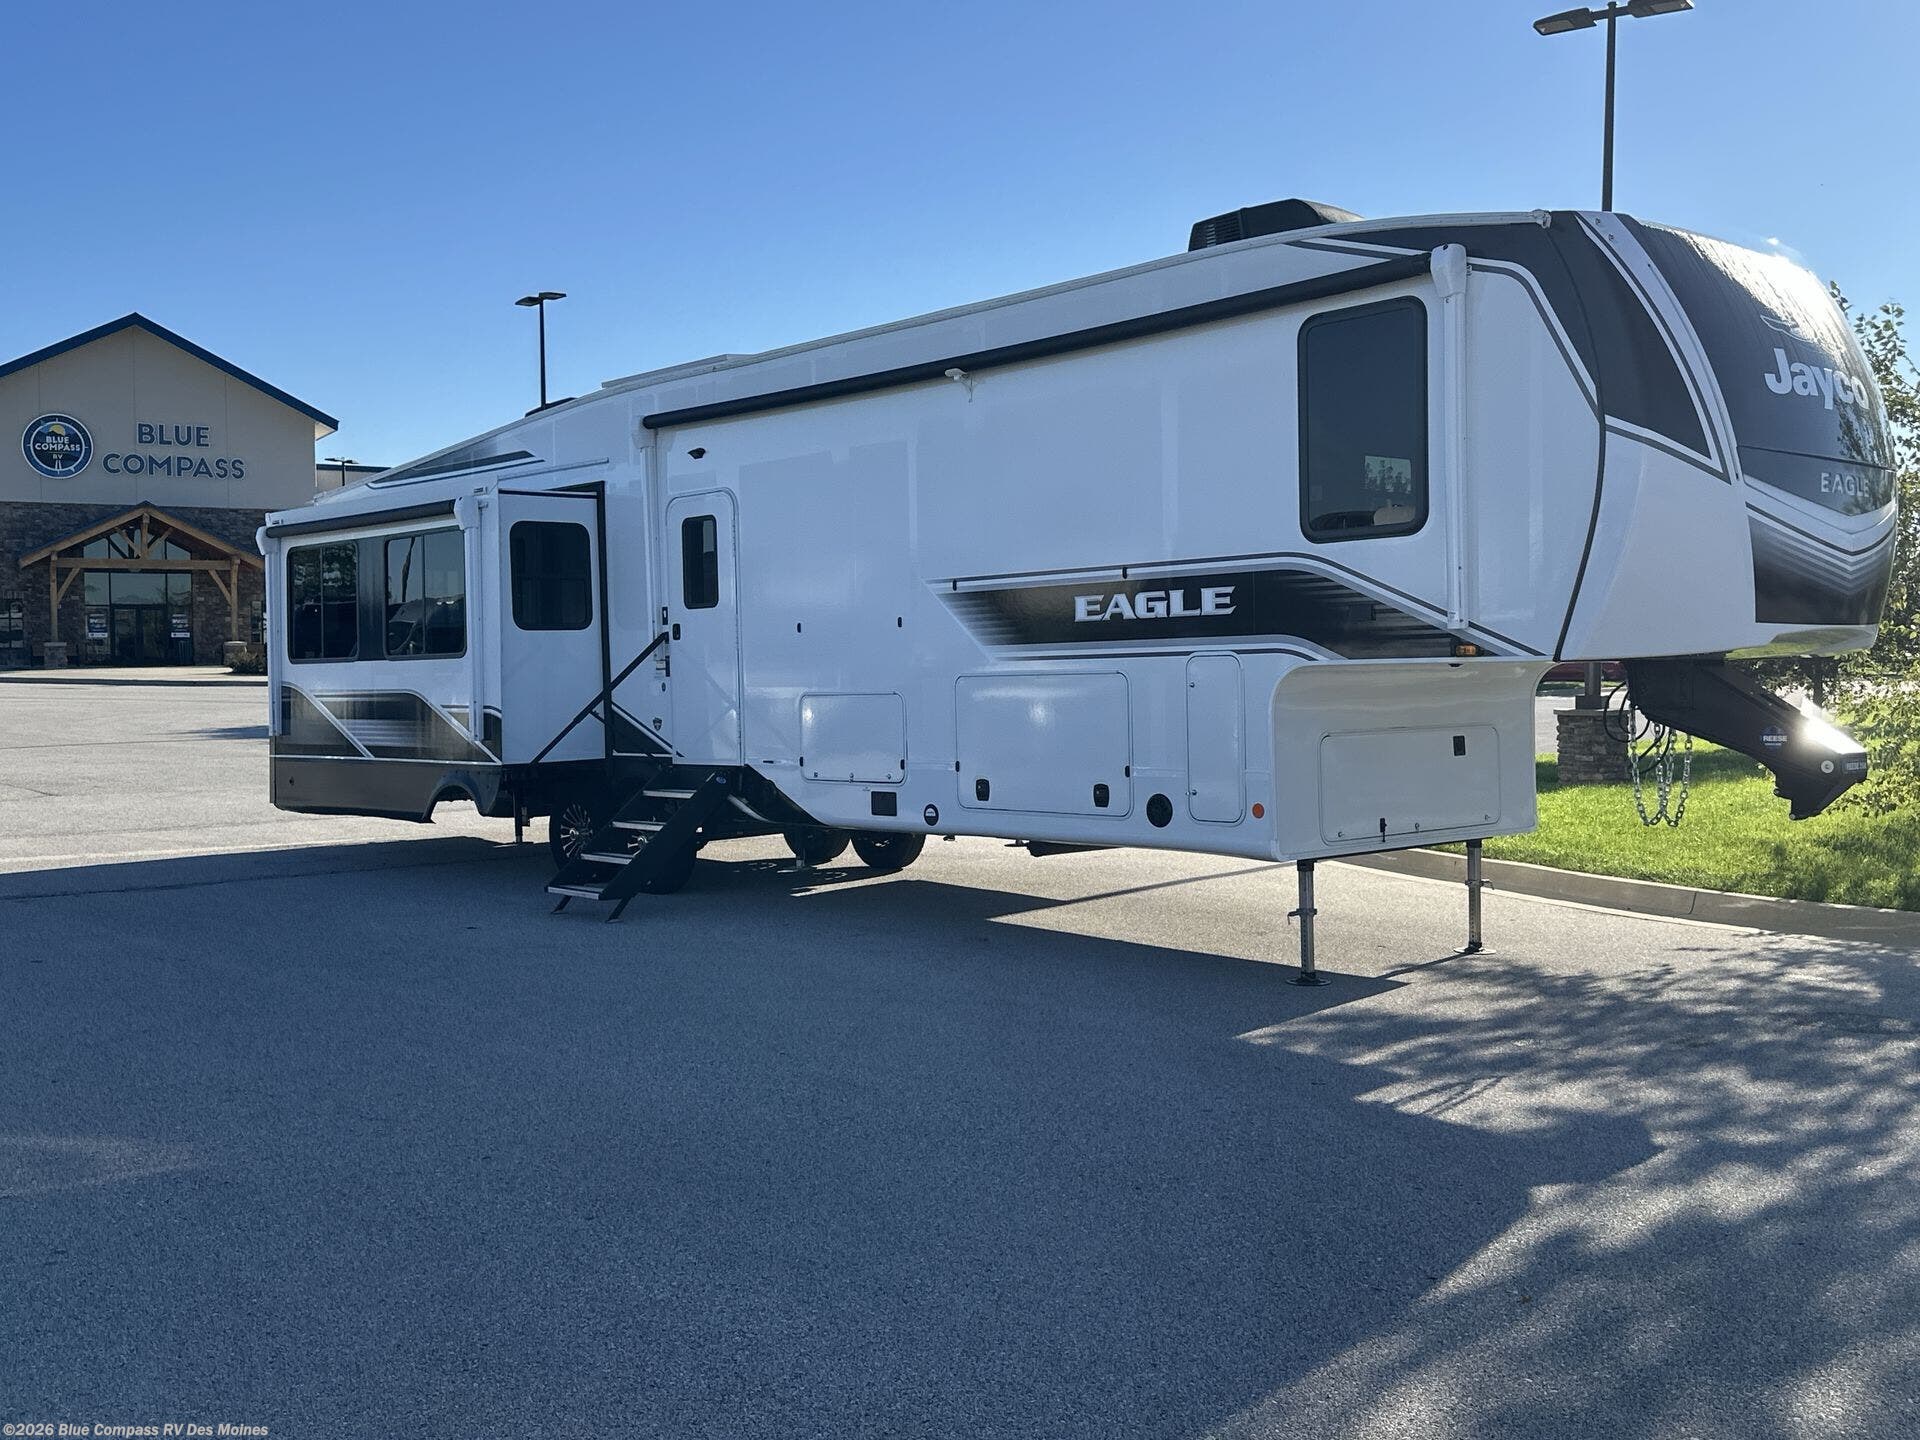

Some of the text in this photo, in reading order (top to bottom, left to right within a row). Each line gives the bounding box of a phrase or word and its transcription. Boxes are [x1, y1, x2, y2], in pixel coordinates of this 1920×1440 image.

[1764, 348, 1869, 410] Jayco
[35, 443, 80, 452] COMPASS
[45, 435, 70, 444] BLUE
[137, 422, 210, 447] BLUE
[102, 453, 245, 480] COMPASS
[1820, 472, 1870, 498] EAGLE
[1074, 585, 1237, 623] EAGLE
